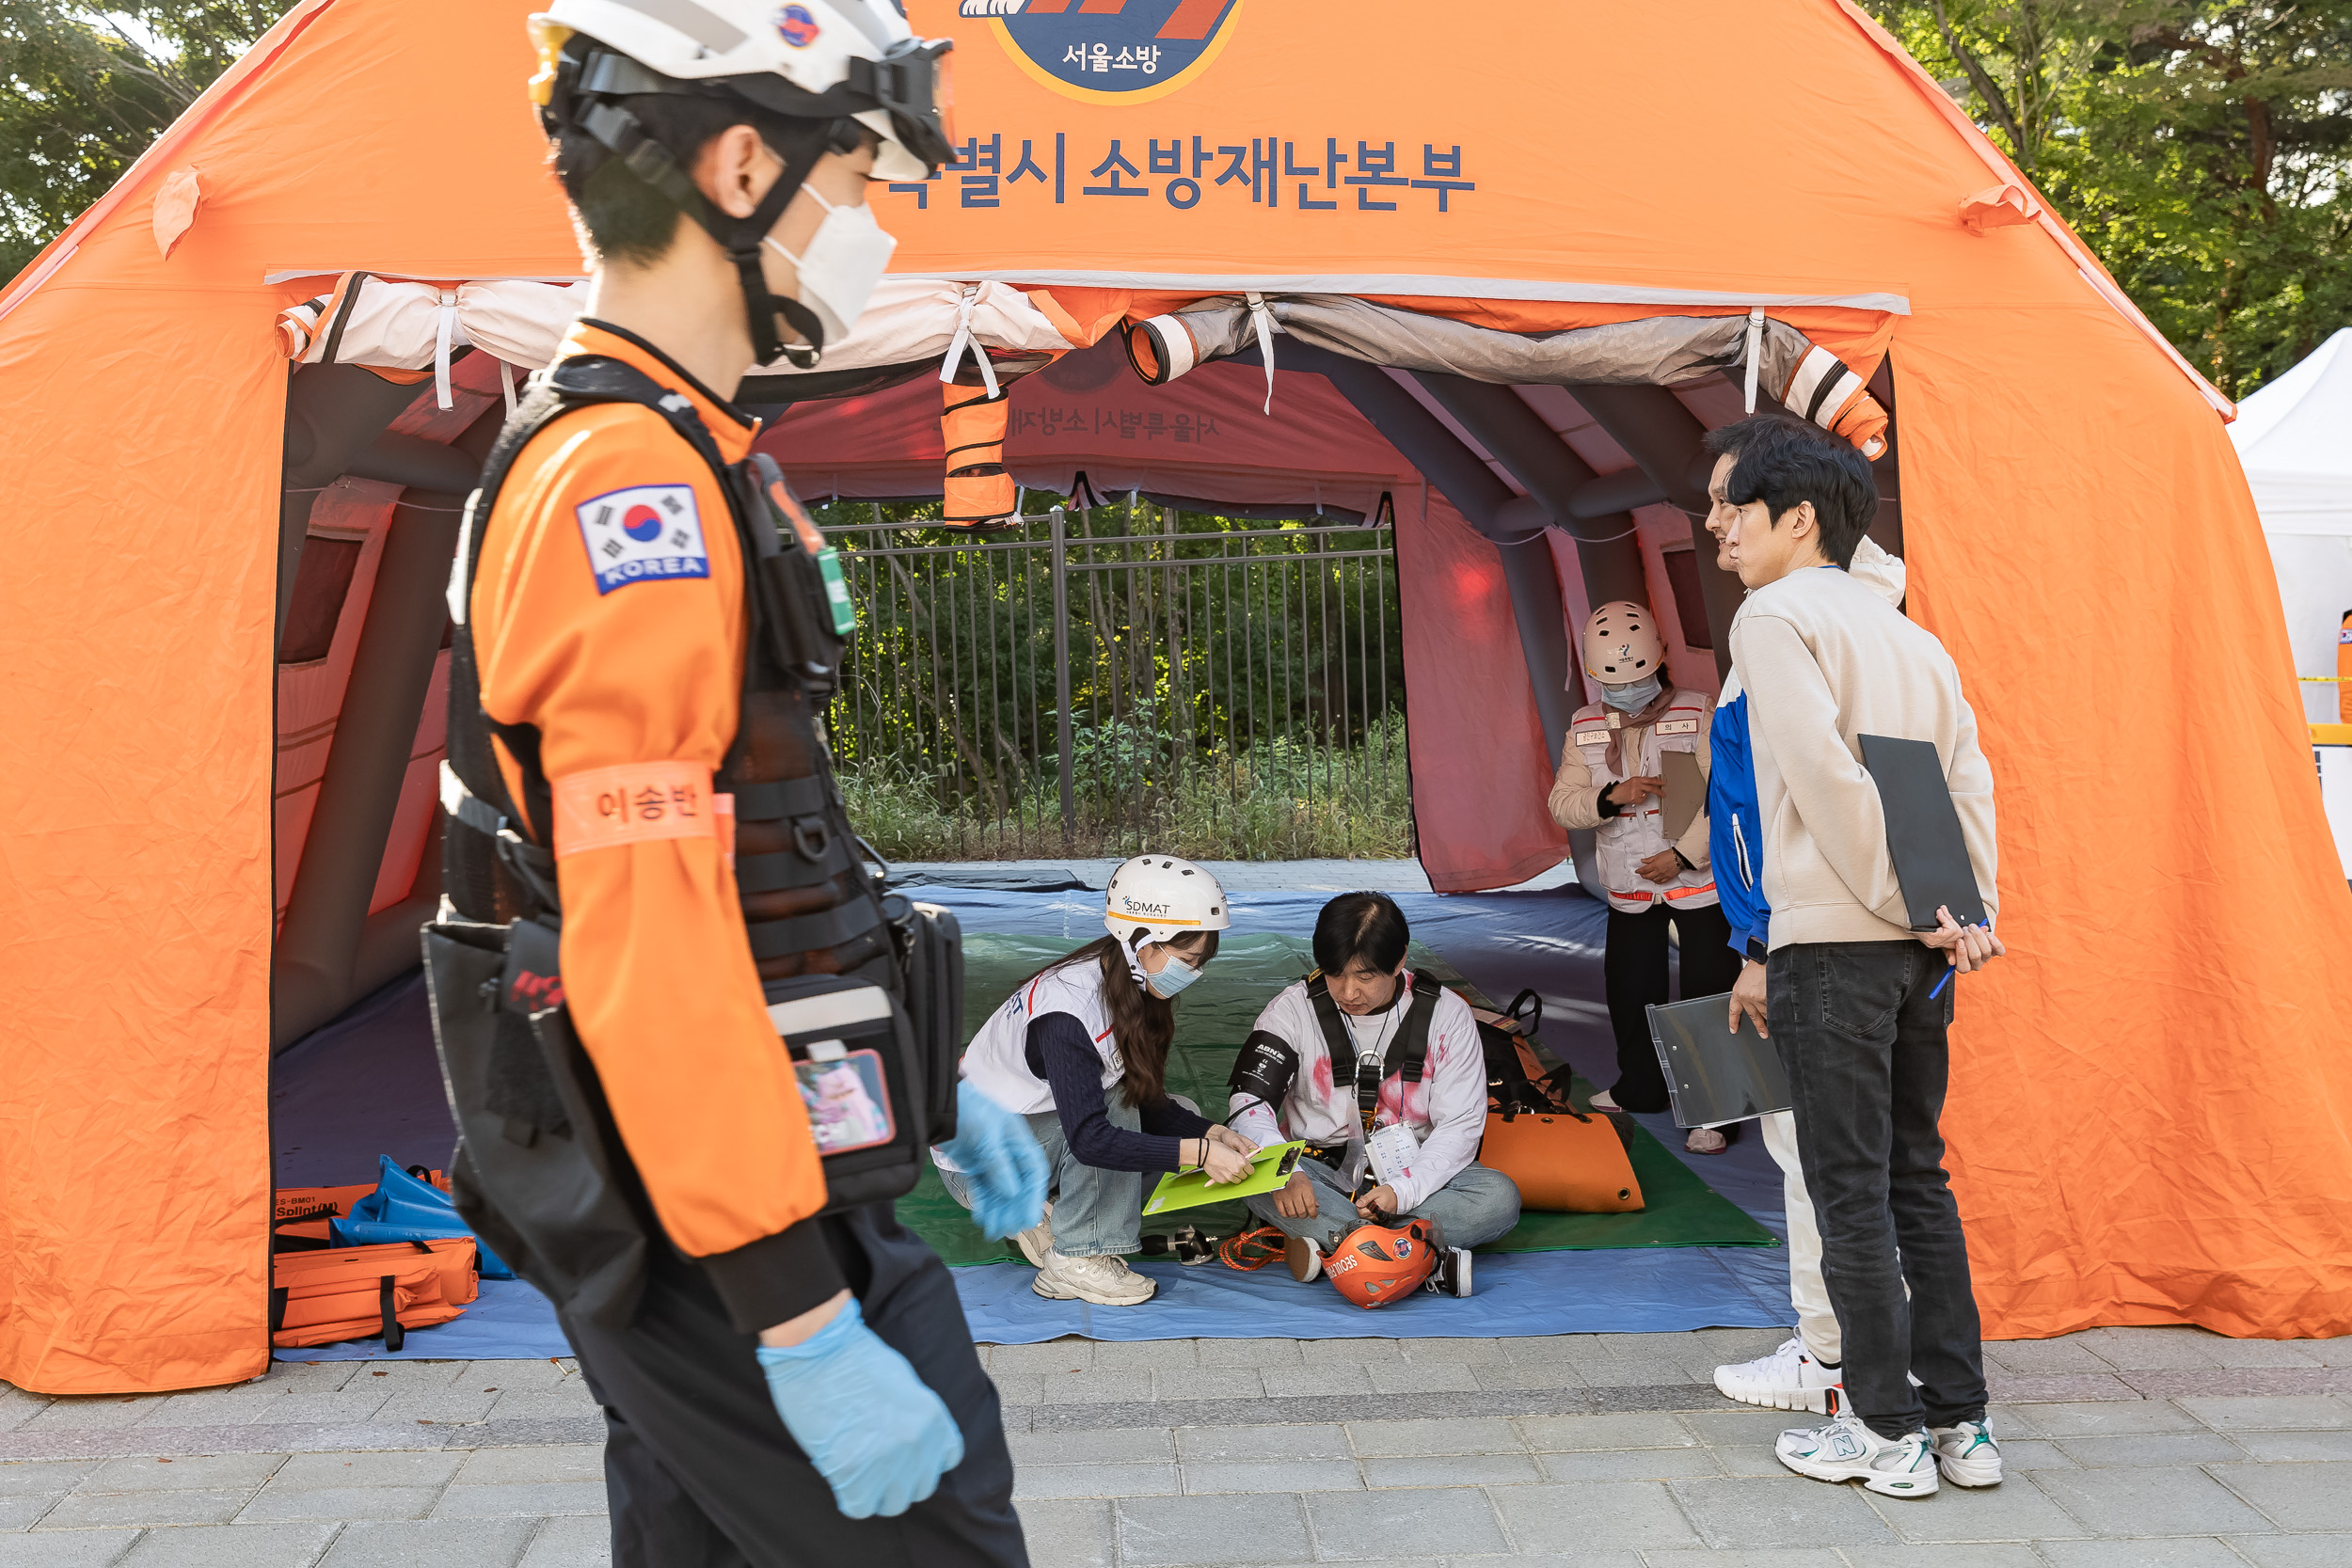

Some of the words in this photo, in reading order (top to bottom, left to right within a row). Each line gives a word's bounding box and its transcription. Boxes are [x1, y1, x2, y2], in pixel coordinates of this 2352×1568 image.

[1062, 42, 1162, 74] 서울소방
[1083, 134, 1475, 213] 소방재난본부
[604, 557, 704, 585] KOREA
[596, 784, 698, 823] 이송반
[1126, 900, 1170, 914] SDMAT
[1257, 1044, 1278, 1055] ABN
[1333, 1254, 1359, 1275] SEOUL
